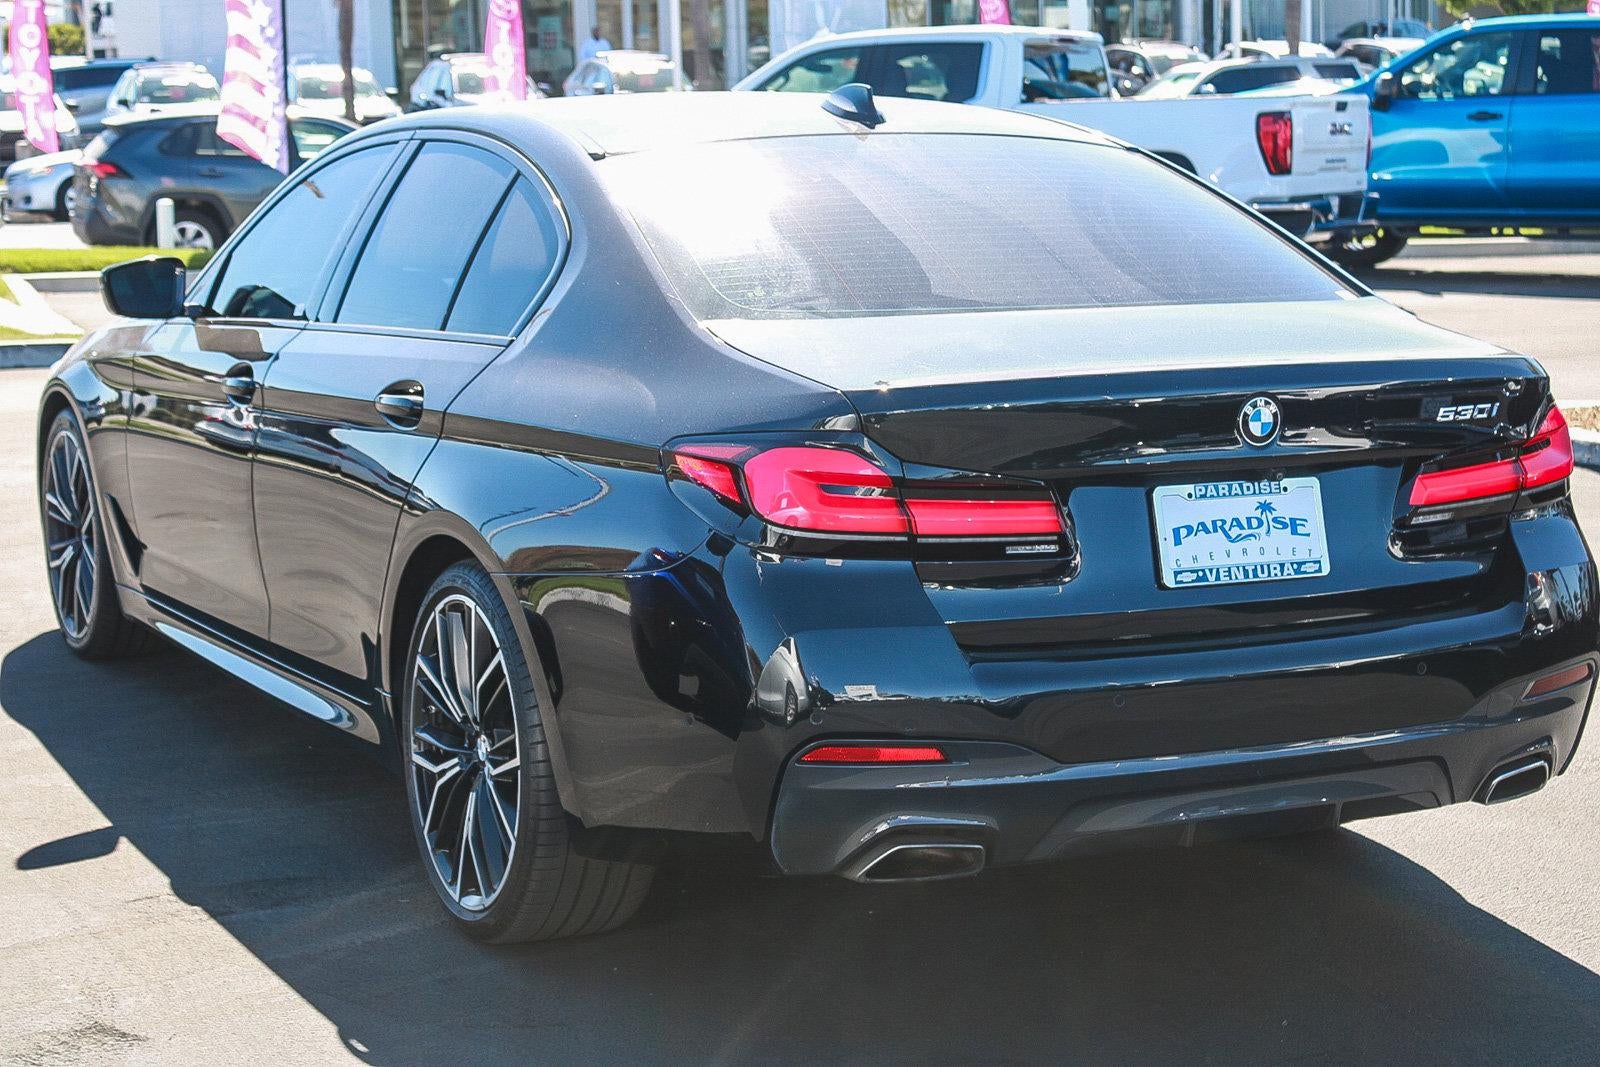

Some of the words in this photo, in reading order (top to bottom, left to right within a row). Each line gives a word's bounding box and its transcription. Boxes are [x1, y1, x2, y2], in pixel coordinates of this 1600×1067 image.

[1244, 398, 1278, 416] BMW
[1195, 481, 1281, 499] PARADISE
[1172, 500, 1311, 547] PARADISE
[1175, 546, 1313, 568] CHEVROLET
[1204, 563, 1295, 582] VENTURA
